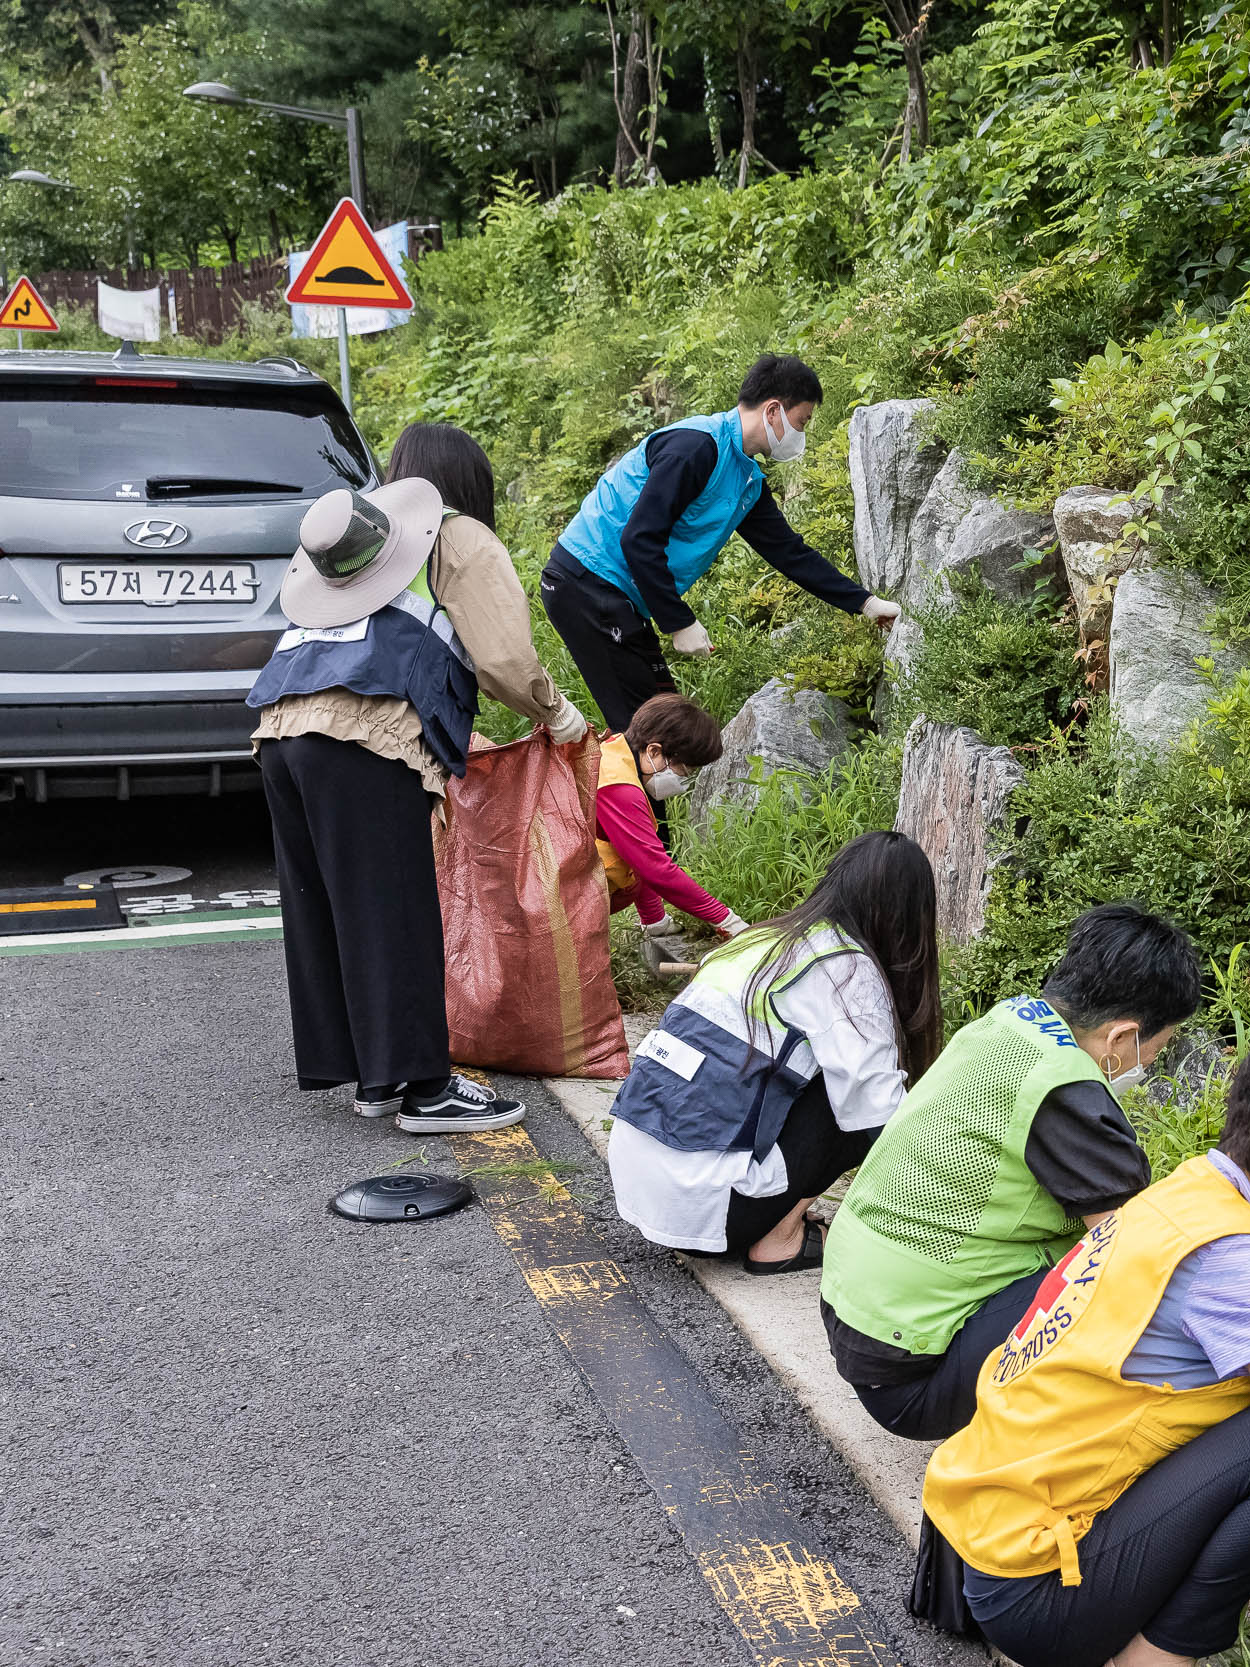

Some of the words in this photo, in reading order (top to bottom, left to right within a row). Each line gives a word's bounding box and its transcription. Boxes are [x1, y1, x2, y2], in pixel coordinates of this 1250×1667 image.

[80, 570, 141, 596] 57저
[157, 570, 237, 596] 7244
[1011, 1305, 1072, 1377] CROSS
